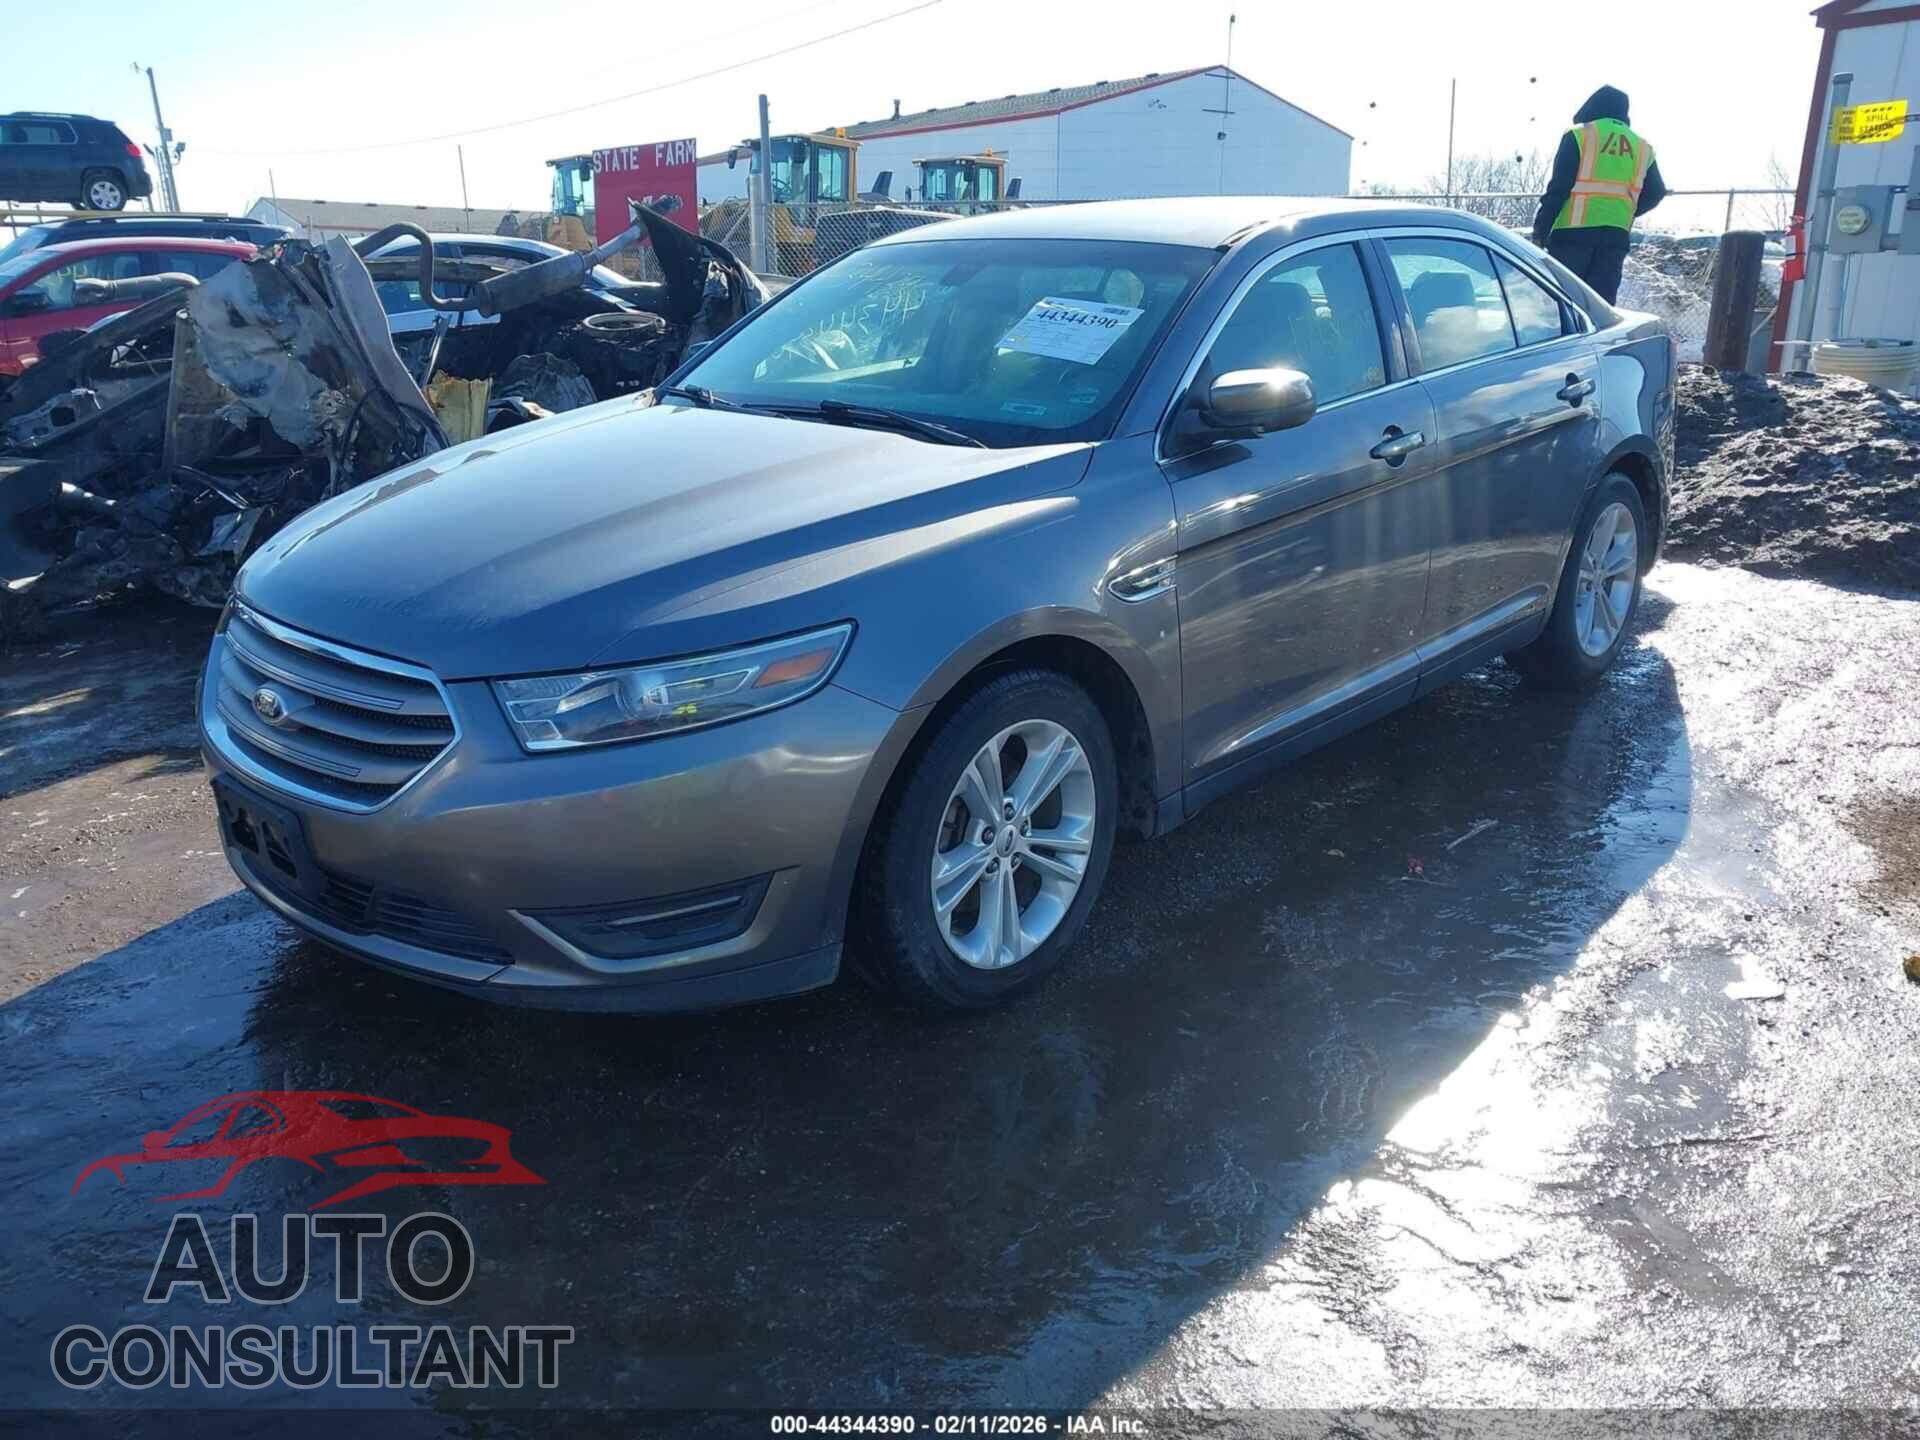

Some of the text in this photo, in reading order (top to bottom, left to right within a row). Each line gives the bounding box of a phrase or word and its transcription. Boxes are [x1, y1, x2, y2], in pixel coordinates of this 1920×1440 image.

[593, 139, 696, 174] STATE FARM
[1038, 309, 1118, 329] 44344390
